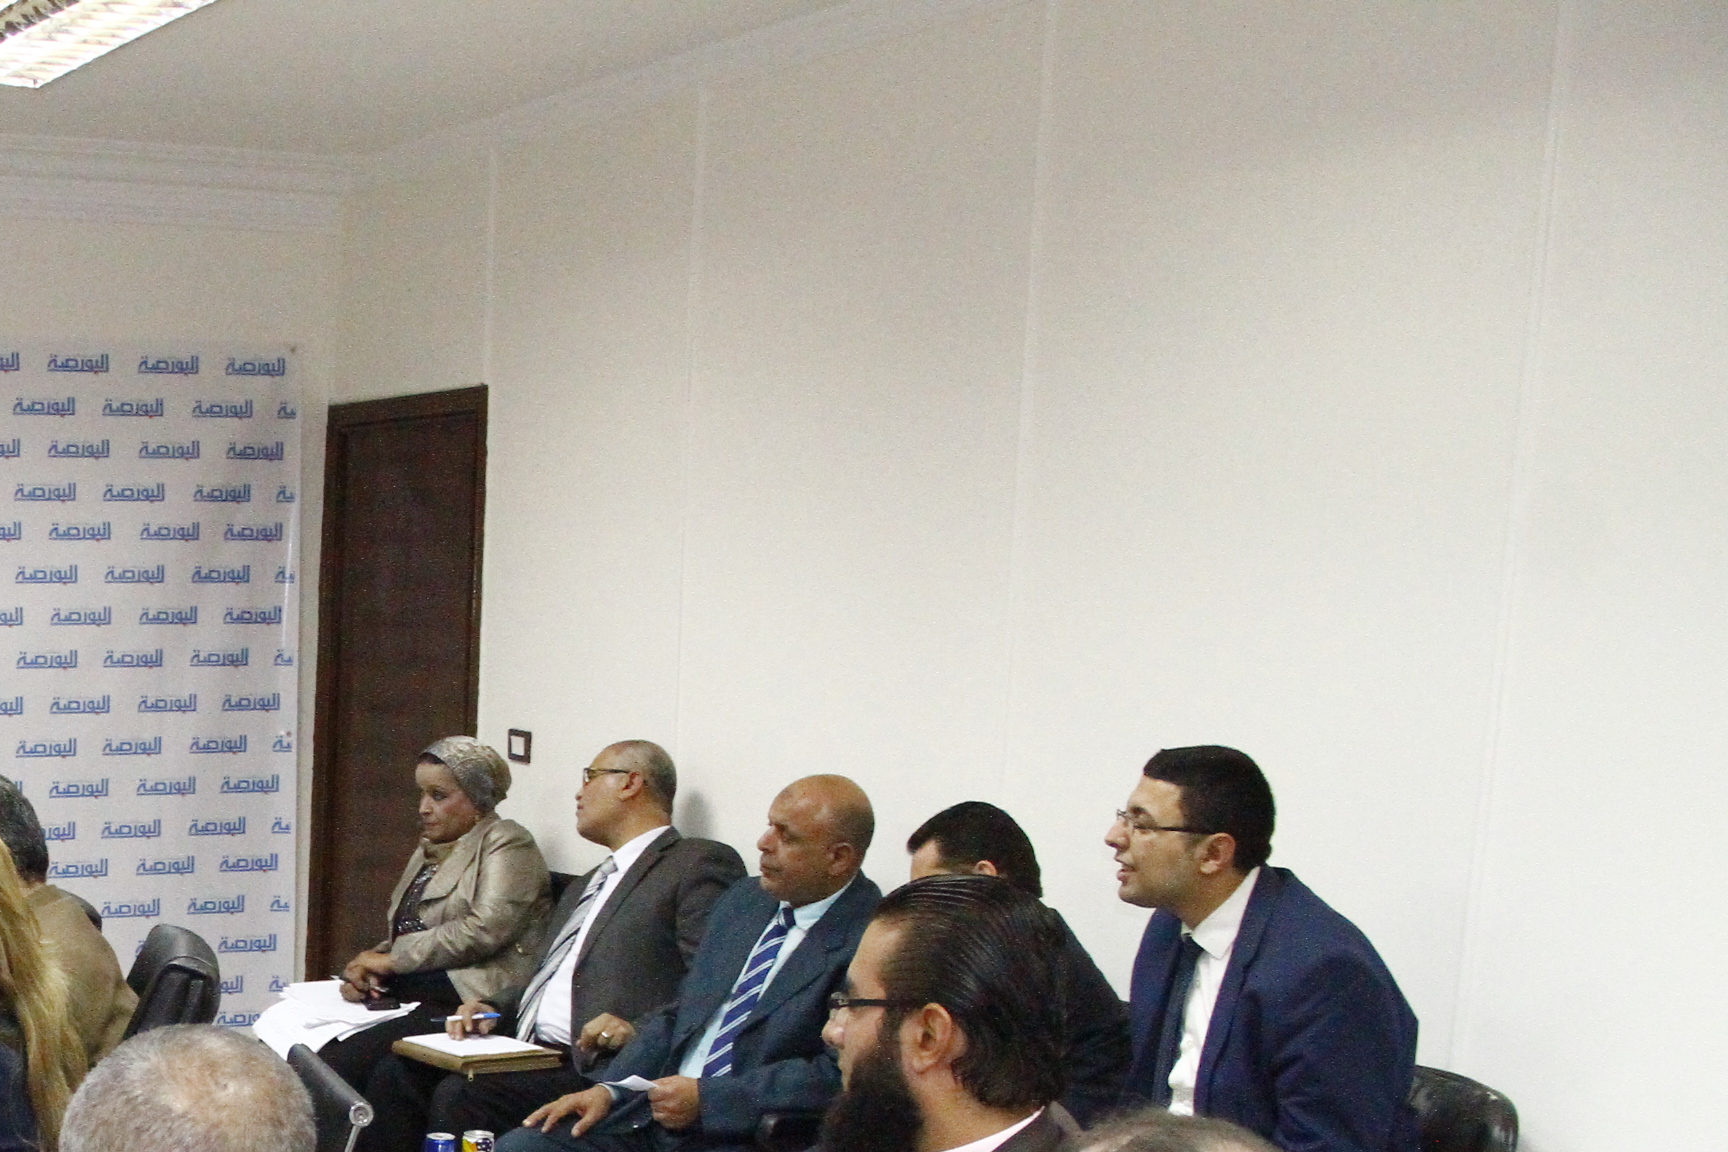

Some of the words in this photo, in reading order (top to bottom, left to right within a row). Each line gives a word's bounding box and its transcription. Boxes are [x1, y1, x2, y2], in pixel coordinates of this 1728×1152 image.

[48, 354, 109, 372] البورصة
[139, 355, 199, 374] البورصة
[226, 357, 286, 376] البورصة
[13, 397, 75, 415] البورصة
[103, 399, 164, 416] البورصة
[195, 400, 253, 418] البورصة
[48, 440, 110, 458] البورصة
[140, 441, 200, 459] البورصة
[226, 442, 283, 460] البورصة
[15, 483, 76, 501] البورصة
[103, 484, 165, 502] البورصة
[194, 484, 251, 502] البورصة
[49, 522, 111, 541] البورصة
[140, 522, 199, 540] البورصة
[225, 522, 284, 541] البورصة
[16, 565, 78, 583] البورصة
[105, 565, 164, 583] البورصة
[192, 565, 250, 583] البورصة
[51, 607, 111, 626] البورصة
[139, 606, 197, 625] البورصة
[224, 606, 282, 624] البورصة
[17, 650, 78, 669] البورصة
[104, 649, 163, 668] البورصة
[192, 648, 249, 666] البورصة
[50, 695, 110, 714] البورصة
[139, 694, 197, 713] البورصة
[223, 693, 280, 711] البورصة
[17, 738, 77, 758] البورصة
[104, 736, 162, 756] البورصة
[191, 735, 247, 753] البورصة
[49, 778, 108, 798] البورصة
[137, 777, 196, 795] البورصة
[222, 775, 279, 793] البورصة
[102, 819, 161, 838] البورصة
[190, 817, 246, 836] البورصة
[50, 859, 108, 878] البورصة
[137, 856, 195, 875] البورصة
[220, 853, 278, 872] البورصة
[101, 899, 160, 920] البورصة
[187, 895, 245, 914] البورصة
[219, 934, 277, 953] البورصة
